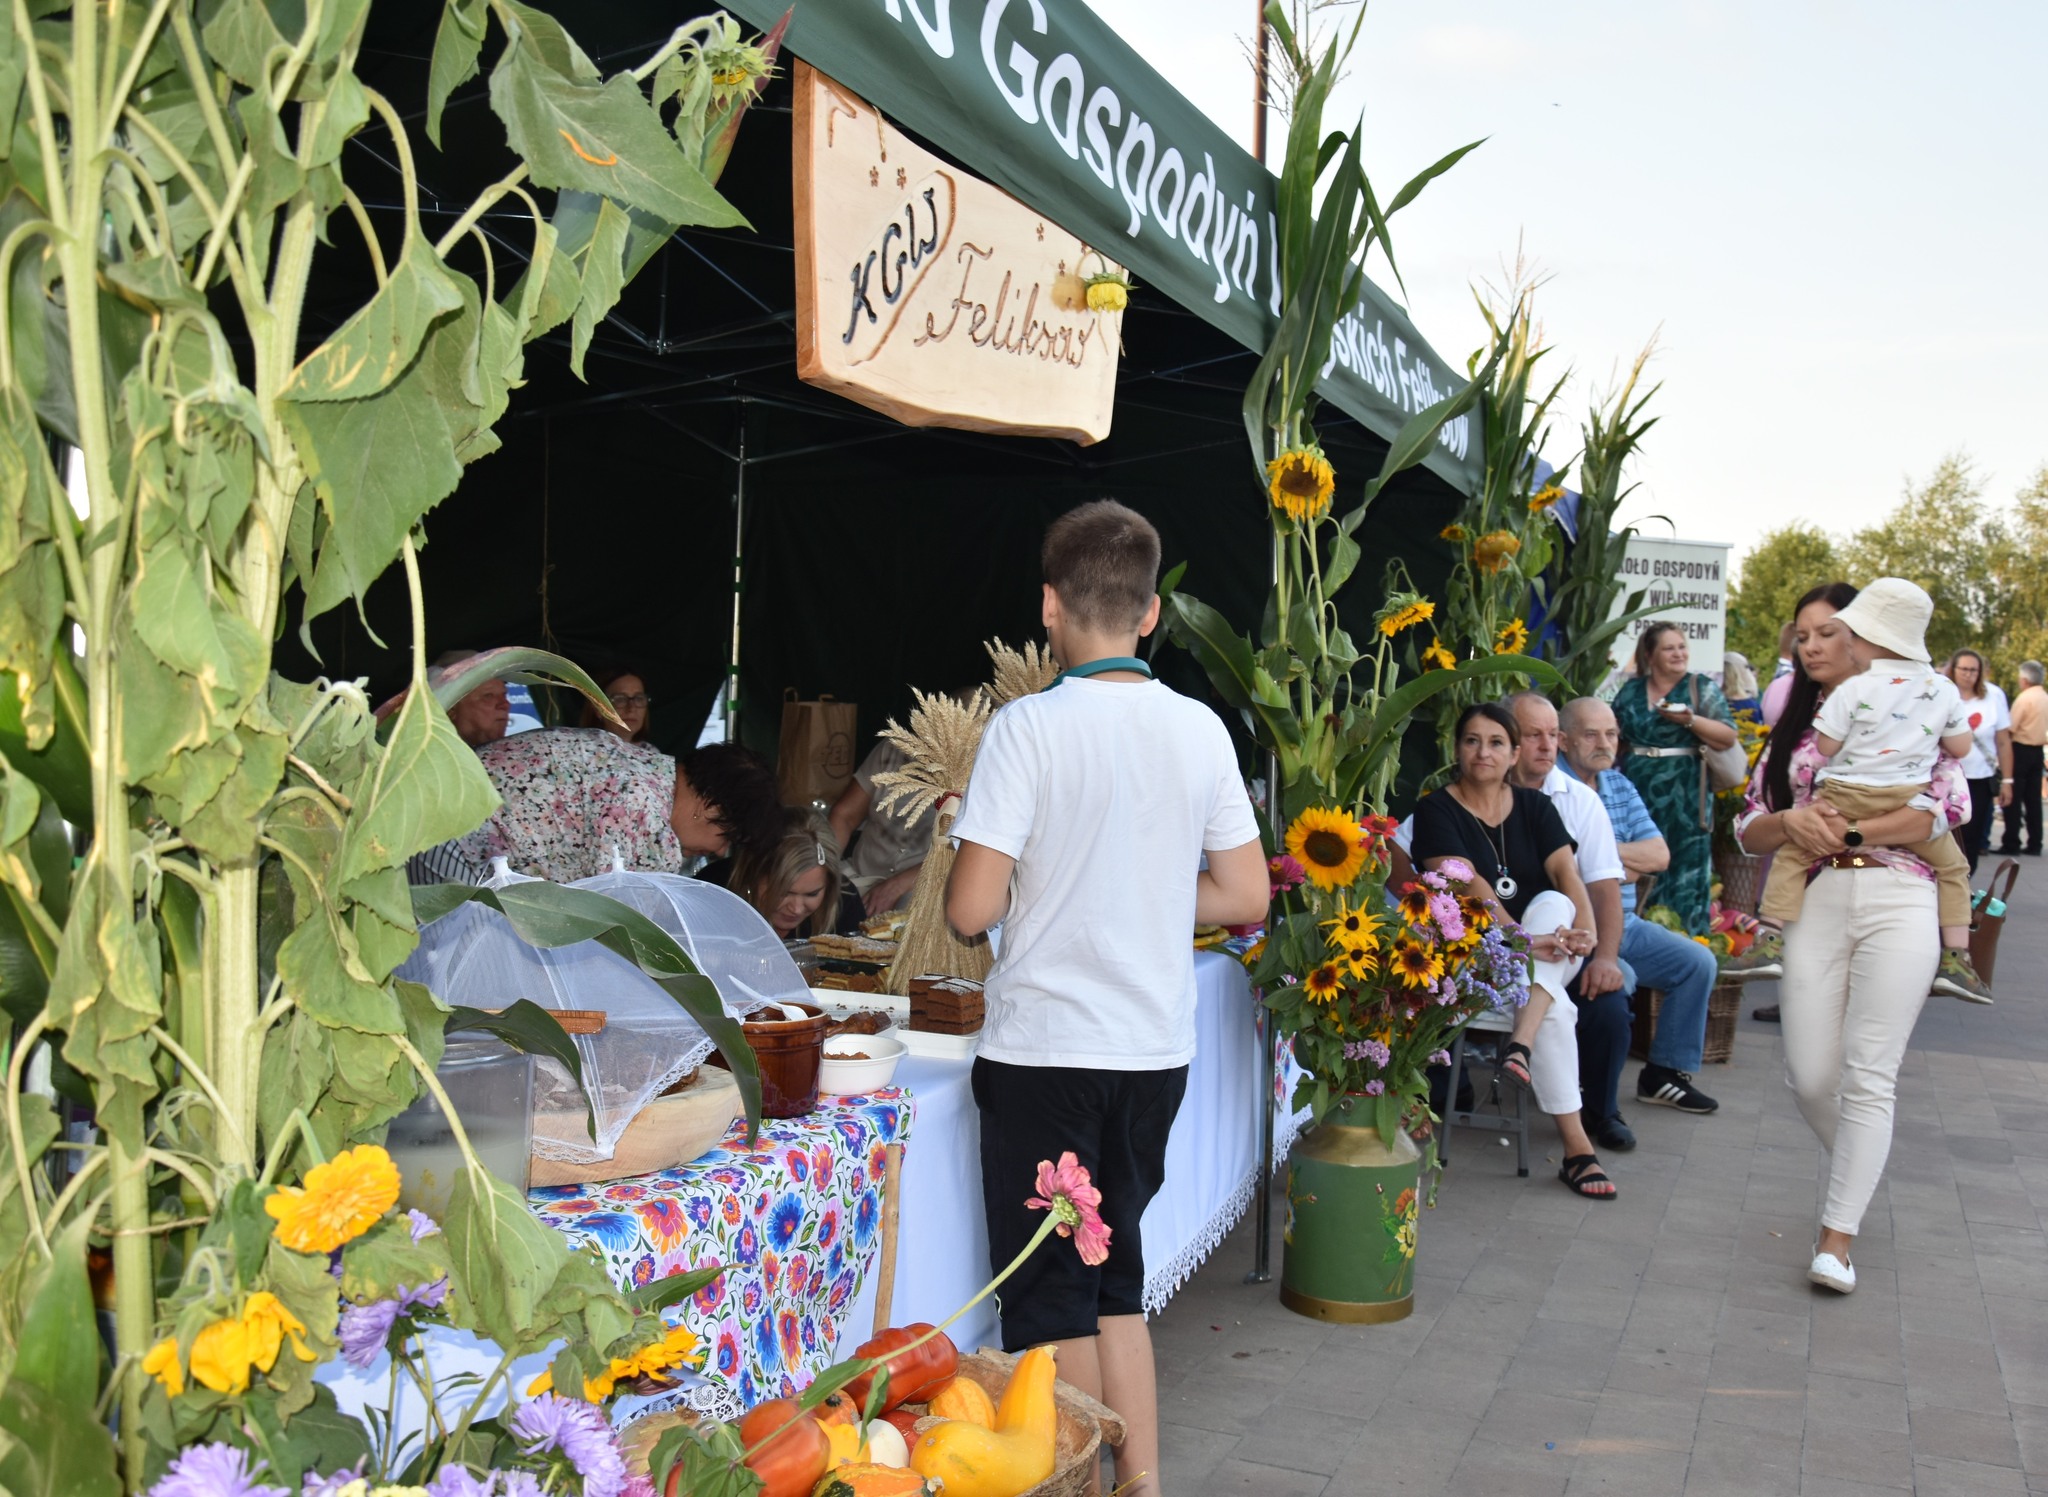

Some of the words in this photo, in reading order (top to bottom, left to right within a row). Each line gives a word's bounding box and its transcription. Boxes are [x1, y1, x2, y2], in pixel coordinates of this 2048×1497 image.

[980, 0, 1259, 304] Gospodyń
[842, 187, 938, 345] KGW
[1654, 560, 1719, 580] GOSPODYŃ
